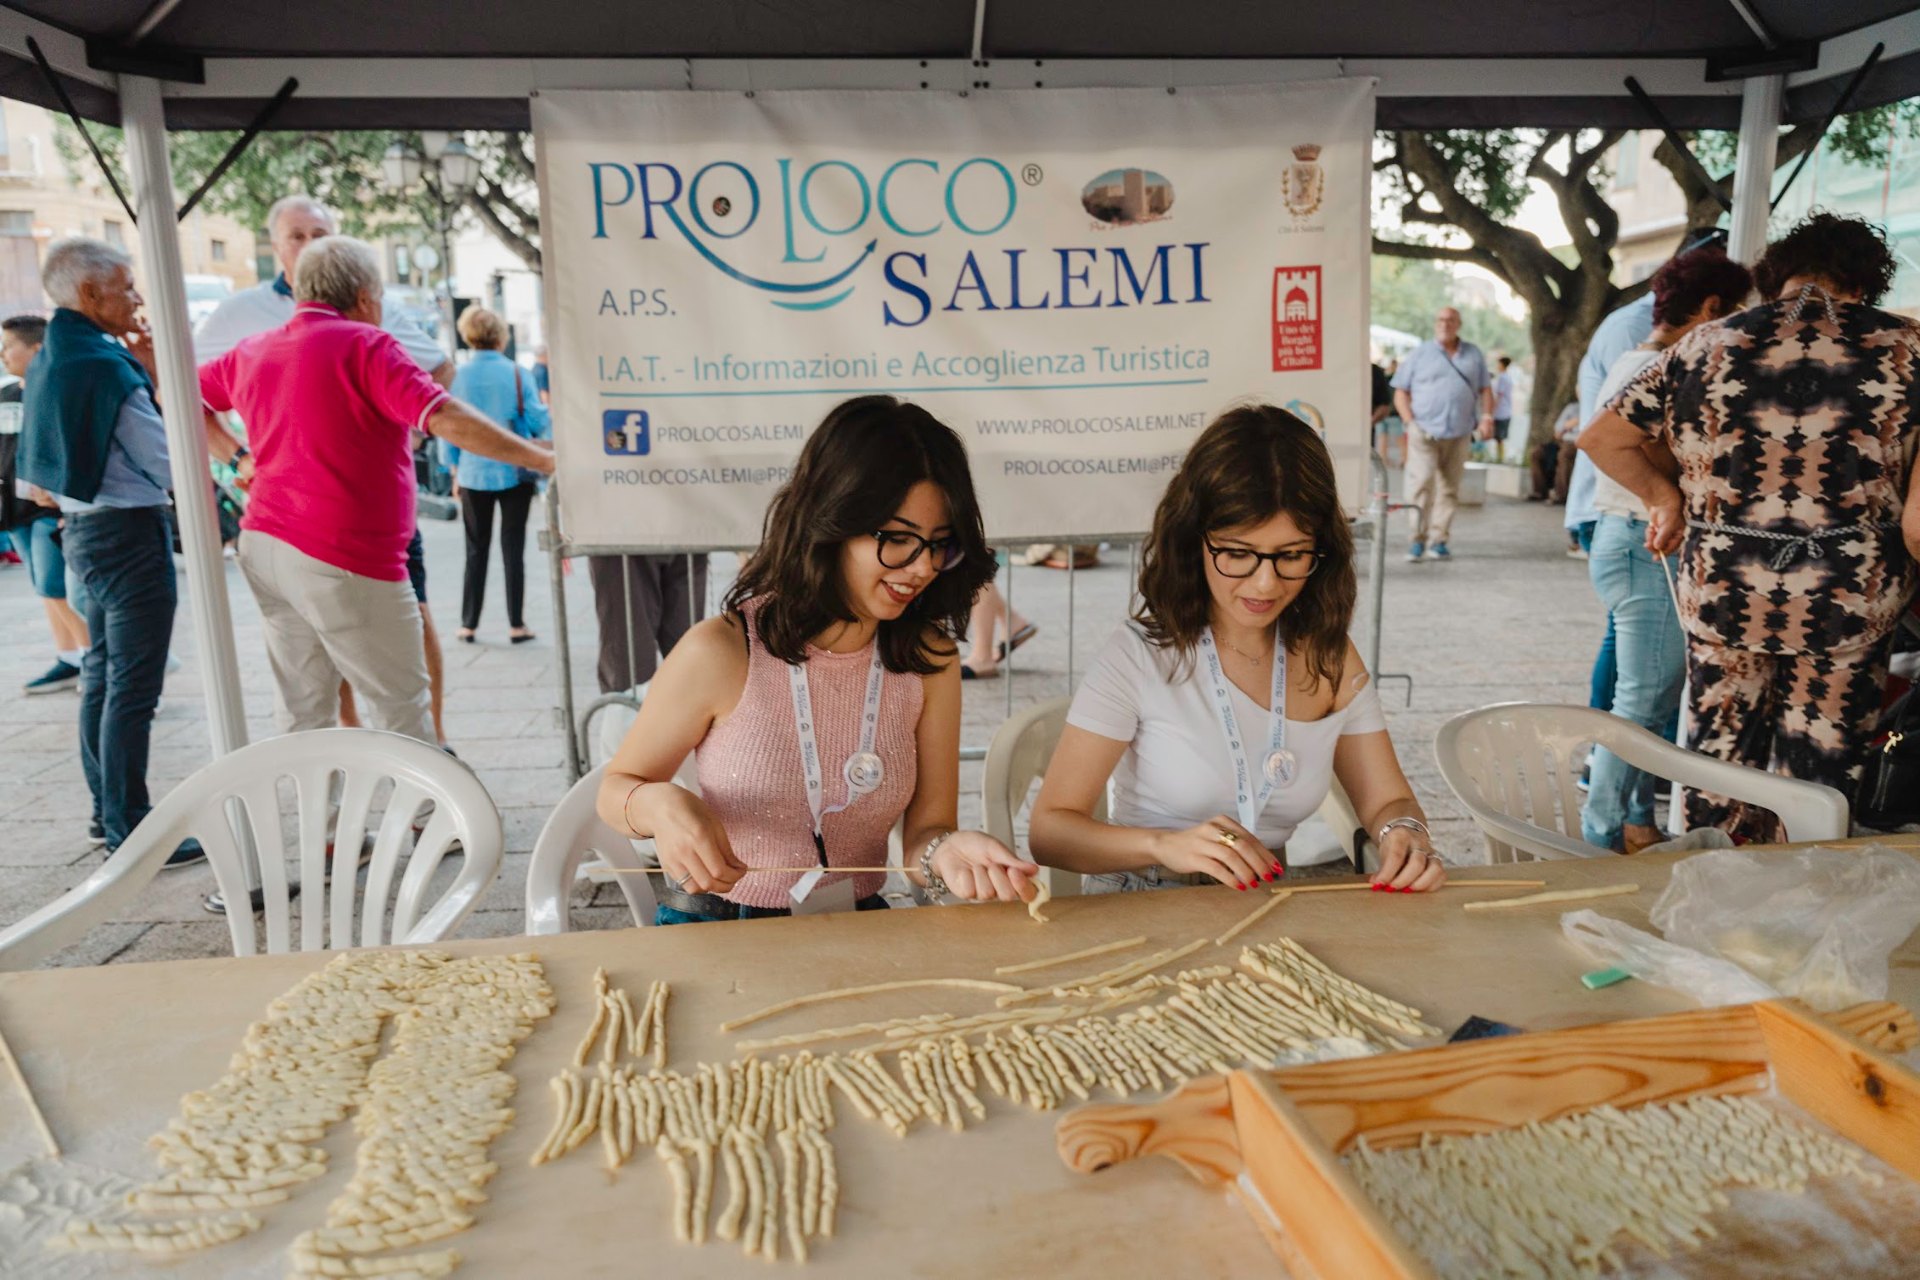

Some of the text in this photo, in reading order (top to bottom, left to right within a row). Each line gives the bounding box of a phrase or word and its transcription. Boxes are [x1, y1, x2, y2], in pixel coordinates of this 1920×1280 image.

[882, 242, 1213, 328] SALEMI
[598, 287, 677, 316] A.P.S.
[598, 355, 667, 383] I.A.T.
[694, 352, 878, 382] Informazioni
[886, 357, 903, 378] e
[911, 350, 1086, 384] Accoglienza
[1091, 344, 1210, 373] Turistica
[656, 424, 804, 442] PROLOCOSALEMI
[976, 411, 1207, 434] WWW.PROLOCOSALEMI.NET
[603, 466, 791, 486] PROLOCOSALEMI@PR
